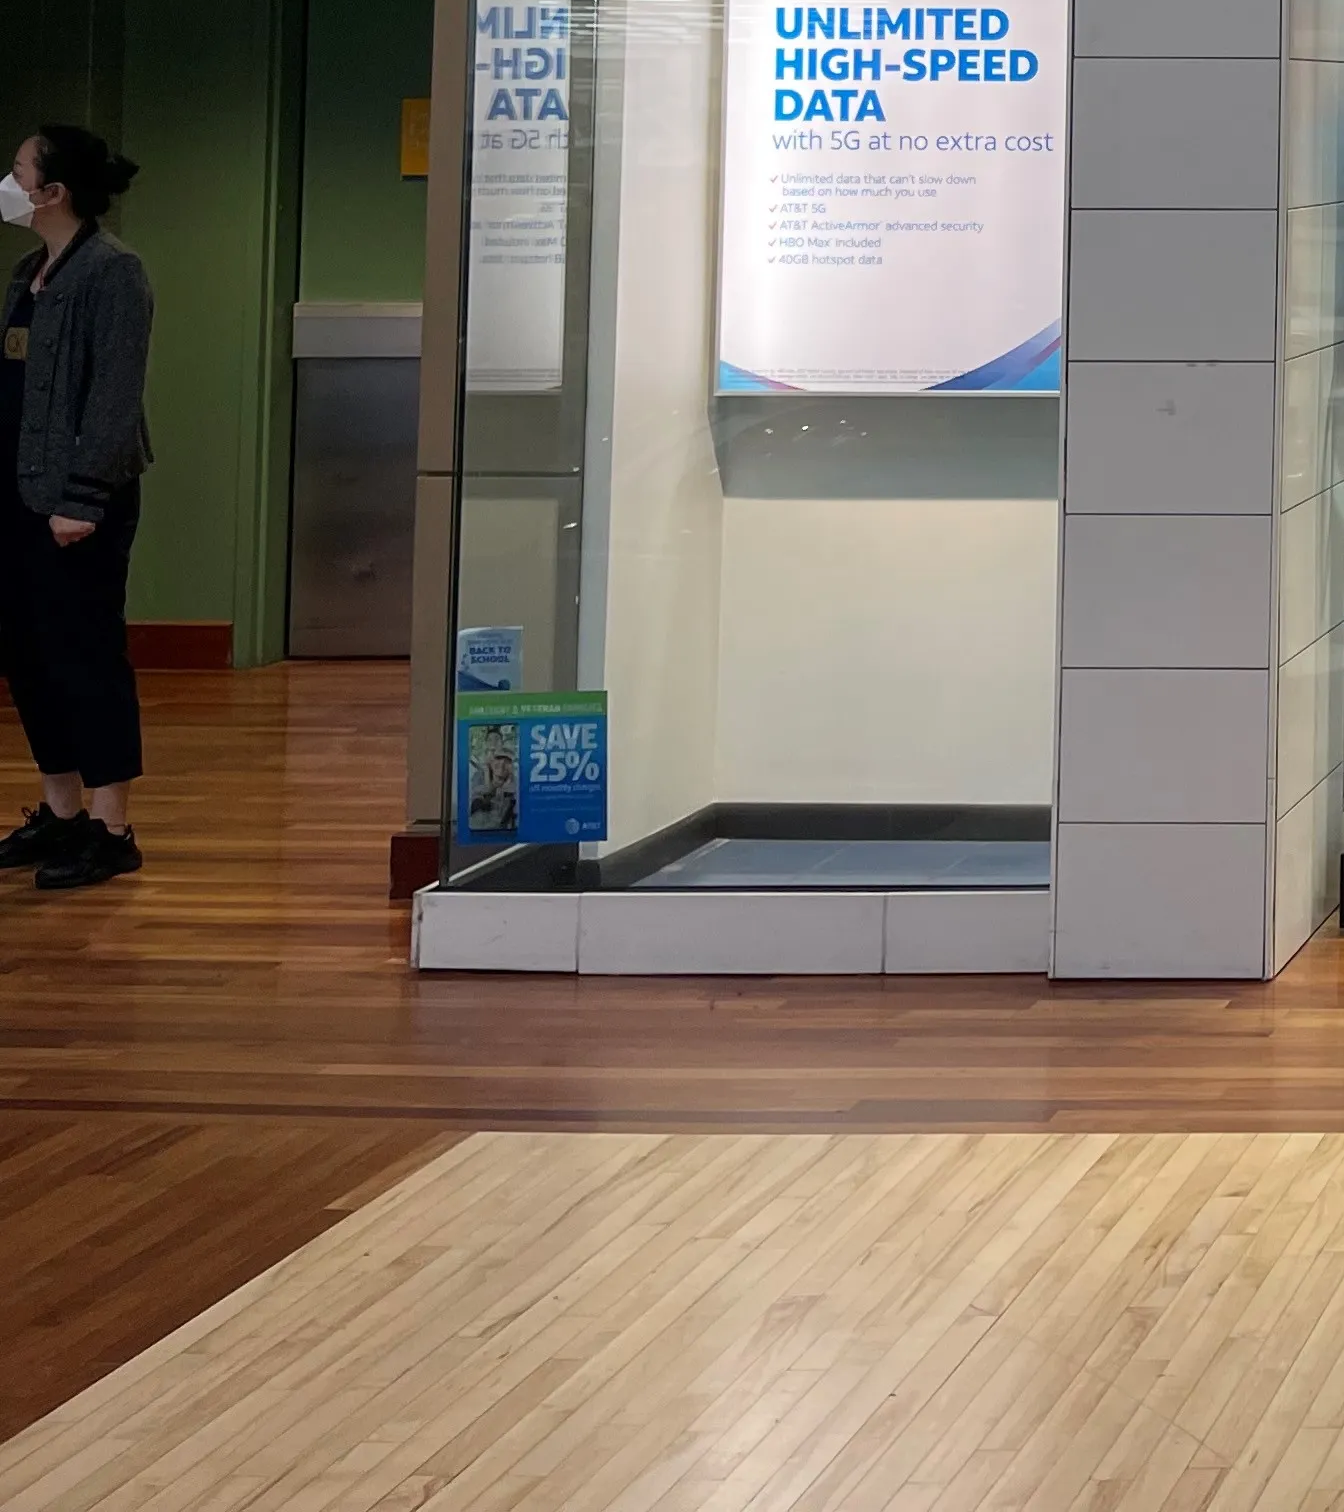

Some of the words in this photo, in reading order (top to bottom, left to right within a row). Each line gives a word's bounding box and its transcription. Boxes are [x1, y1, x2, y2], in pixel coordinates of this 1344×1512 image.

[775, 7, 1010, 40] UNLIMITED
[774, 48, 1039, 82] HIGH-SPEED
[774, 88, 887, 123] DATA
[772, 129, 822, 151] with
[830, 130, 861, 151] 5G
[868, 134, 892, 151] at
[899, 134, 929, 152] no
[936, 133, 997, 152] extra
[1004, 132, 1055, 152] cost
[781, 173, 834, 185] Unlimited
[836, 173, 861, 185] data
[863, 173, 887, 185] that
[918, 173, 943, 185] slow
[946, 173, 977, 185] down
[782, 187, 815, 197] based
[817, 188, 833, 197] on
[835, 187, 859, 197] how
[861, 187, 892, 197] much
[894, 188, 915, 200] you
[917, 188, 937, 197] use
[780, 203, 808, 214] AT&T
[811, 203, 826, 214] 5G
[779, 221, 809, 231] AT&T
[885, 221, 938, 232] advanced
[940, 221, 984, 233] security
[779, 237, 804, 248] HBO
[835, 237, 881, 248] included
[778, 254, 809, 265] 40GB
[812, 254, 855, 267] hotspot
[858, 254, 883, 265] data
[530, 723, 598, 751] SAVE
[529, 751, 600, 783] 25%
